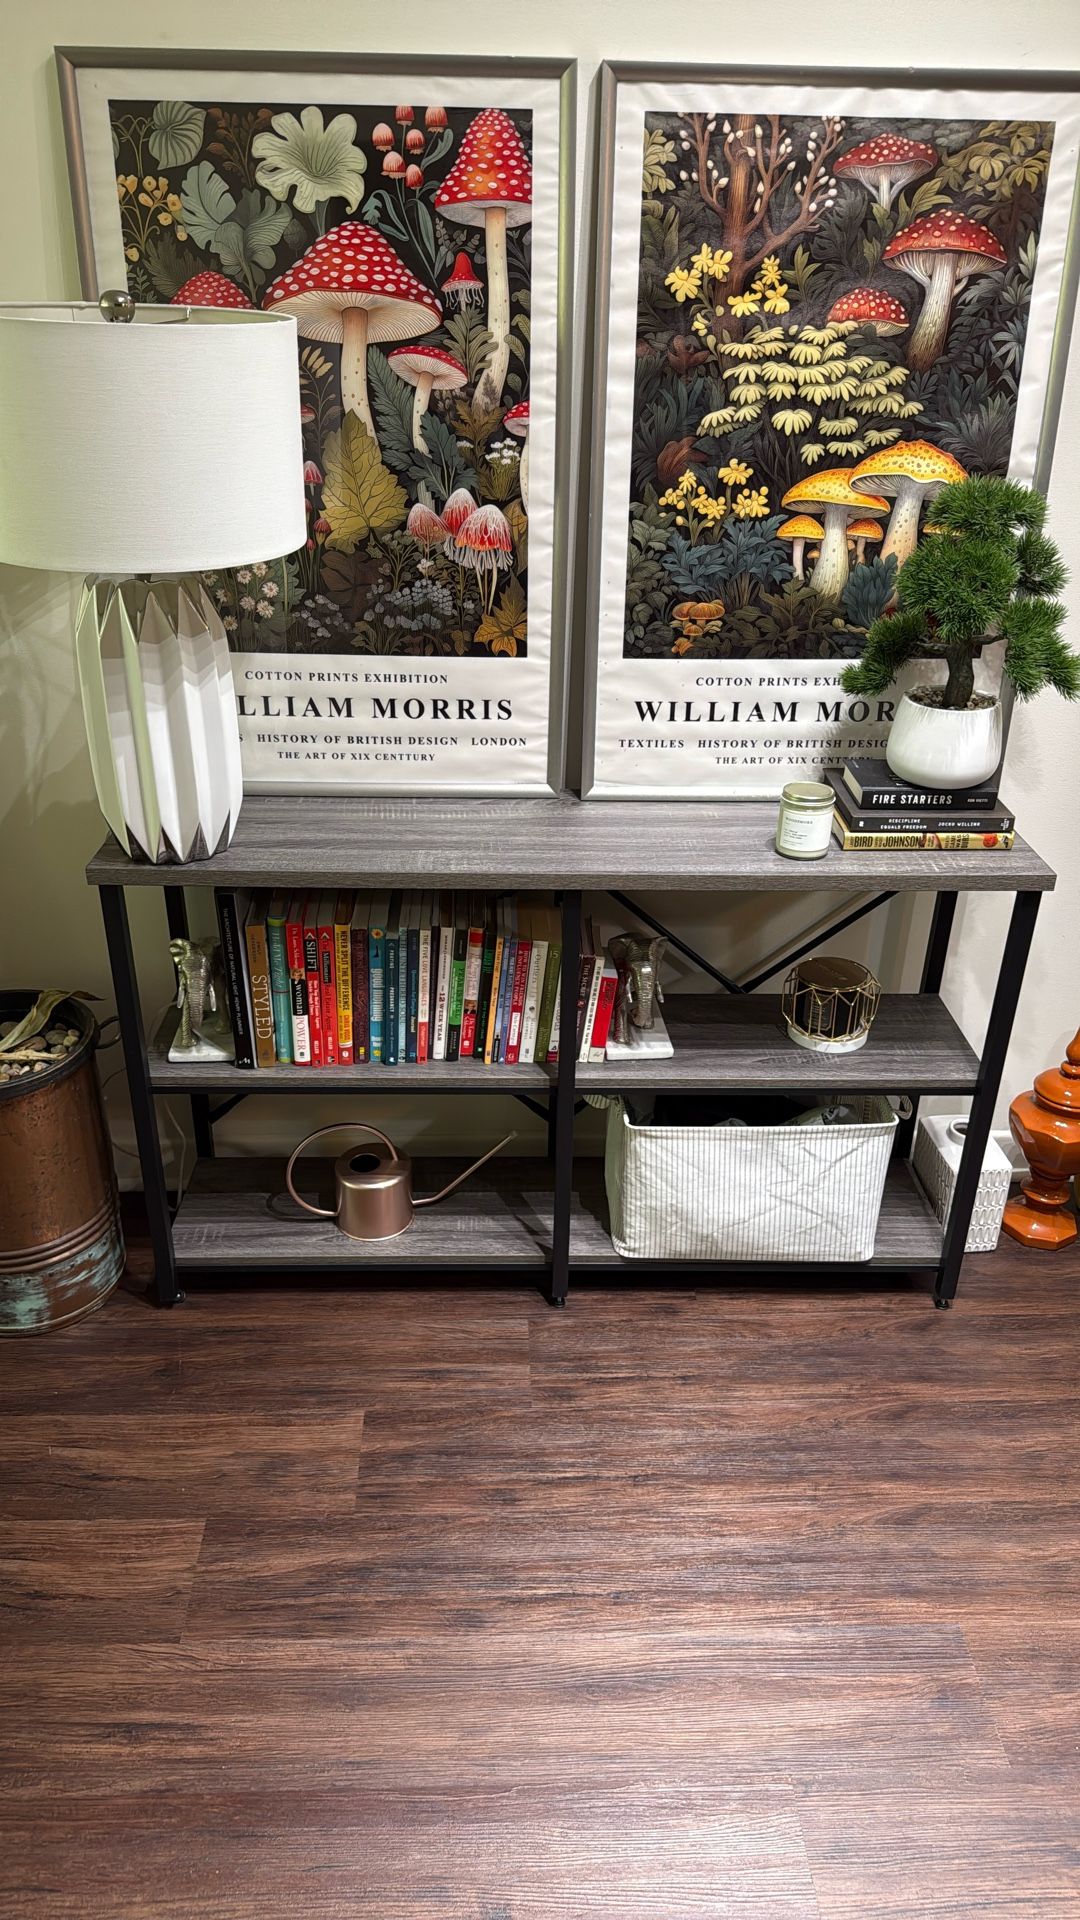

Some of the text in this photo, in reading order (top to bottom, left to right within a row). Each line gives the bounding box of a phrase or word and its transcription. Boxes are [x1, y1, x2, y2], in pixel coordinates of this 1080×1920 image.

[245, 671, 448, 684] COTTON PRINTS EXHIBITION
[696, 677, 752, 686] COTTON
[759, 677, 808, 686] PRINTS
[237, 695, 512, 720] LLIAM MORRIS
[635, 701, 895, 722] WILLIAM MOR
[258, 734, 527, 746] HISTORY OF BRITISH DESIGN LONDON
[618, 739, 888, 748] TEXTILES HISTORY OF BRITISH DESIG
[305, 752, 328, 760] ART
[332, 752, 346, 760] OF
[375, 753, 435, 761] CENTTURY
[715, 756, 738, 764] THE
[742, 756, 764, 764] ART
[769, 756, 783, 764] OF
[788, 756, 808, 764] XIX
[872, 794, 953, 805] FIRE STARTERS
[854, 836, 873, 847] BIRD
[224, 918, 233, 952] ARCHITECTURE
[272, 933, 280, 951] Hold
[273, 954, 281, 965] Me
[306, 941, 317, 971] SHIFT
[228, 961, 238, 982] NATURAL
[371, 968, 385, 988] good
[515, 956, 523, 985] INFLUENCE
[229, 982, 238, 995] LIGHT
[342, 979, 350, 1011] DIFFERENCE
[580, 977, 589, 996] SECRET
[371, 989, 385, 1021] morning
[440, 993, 445, 1002] 12
[252, 975, 271, 1039] STYLED
[295, 984, 306, 1050] woman POWER
